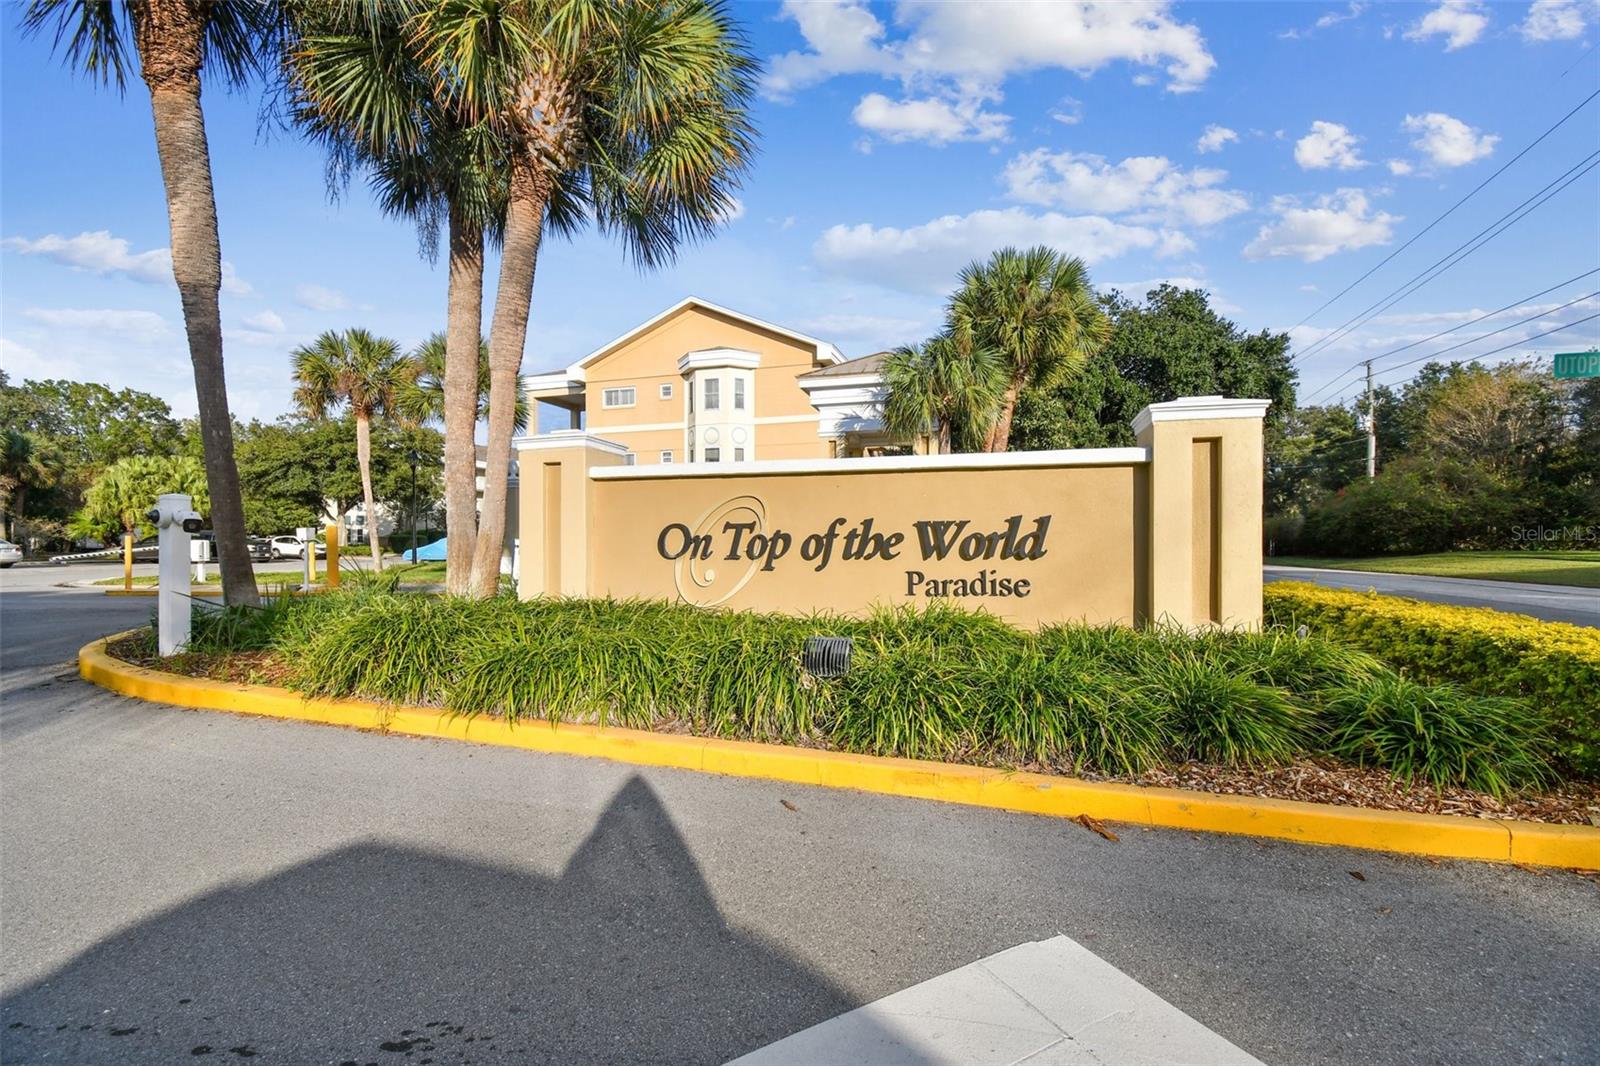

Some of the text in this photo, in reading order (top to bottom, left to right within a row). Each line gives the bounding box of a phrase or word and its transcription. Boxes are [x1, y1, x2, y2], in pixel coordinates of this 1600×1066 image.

[657, 515, 1052, 572] On Top of the World
[904, 569, 1031, 597] Paradise
